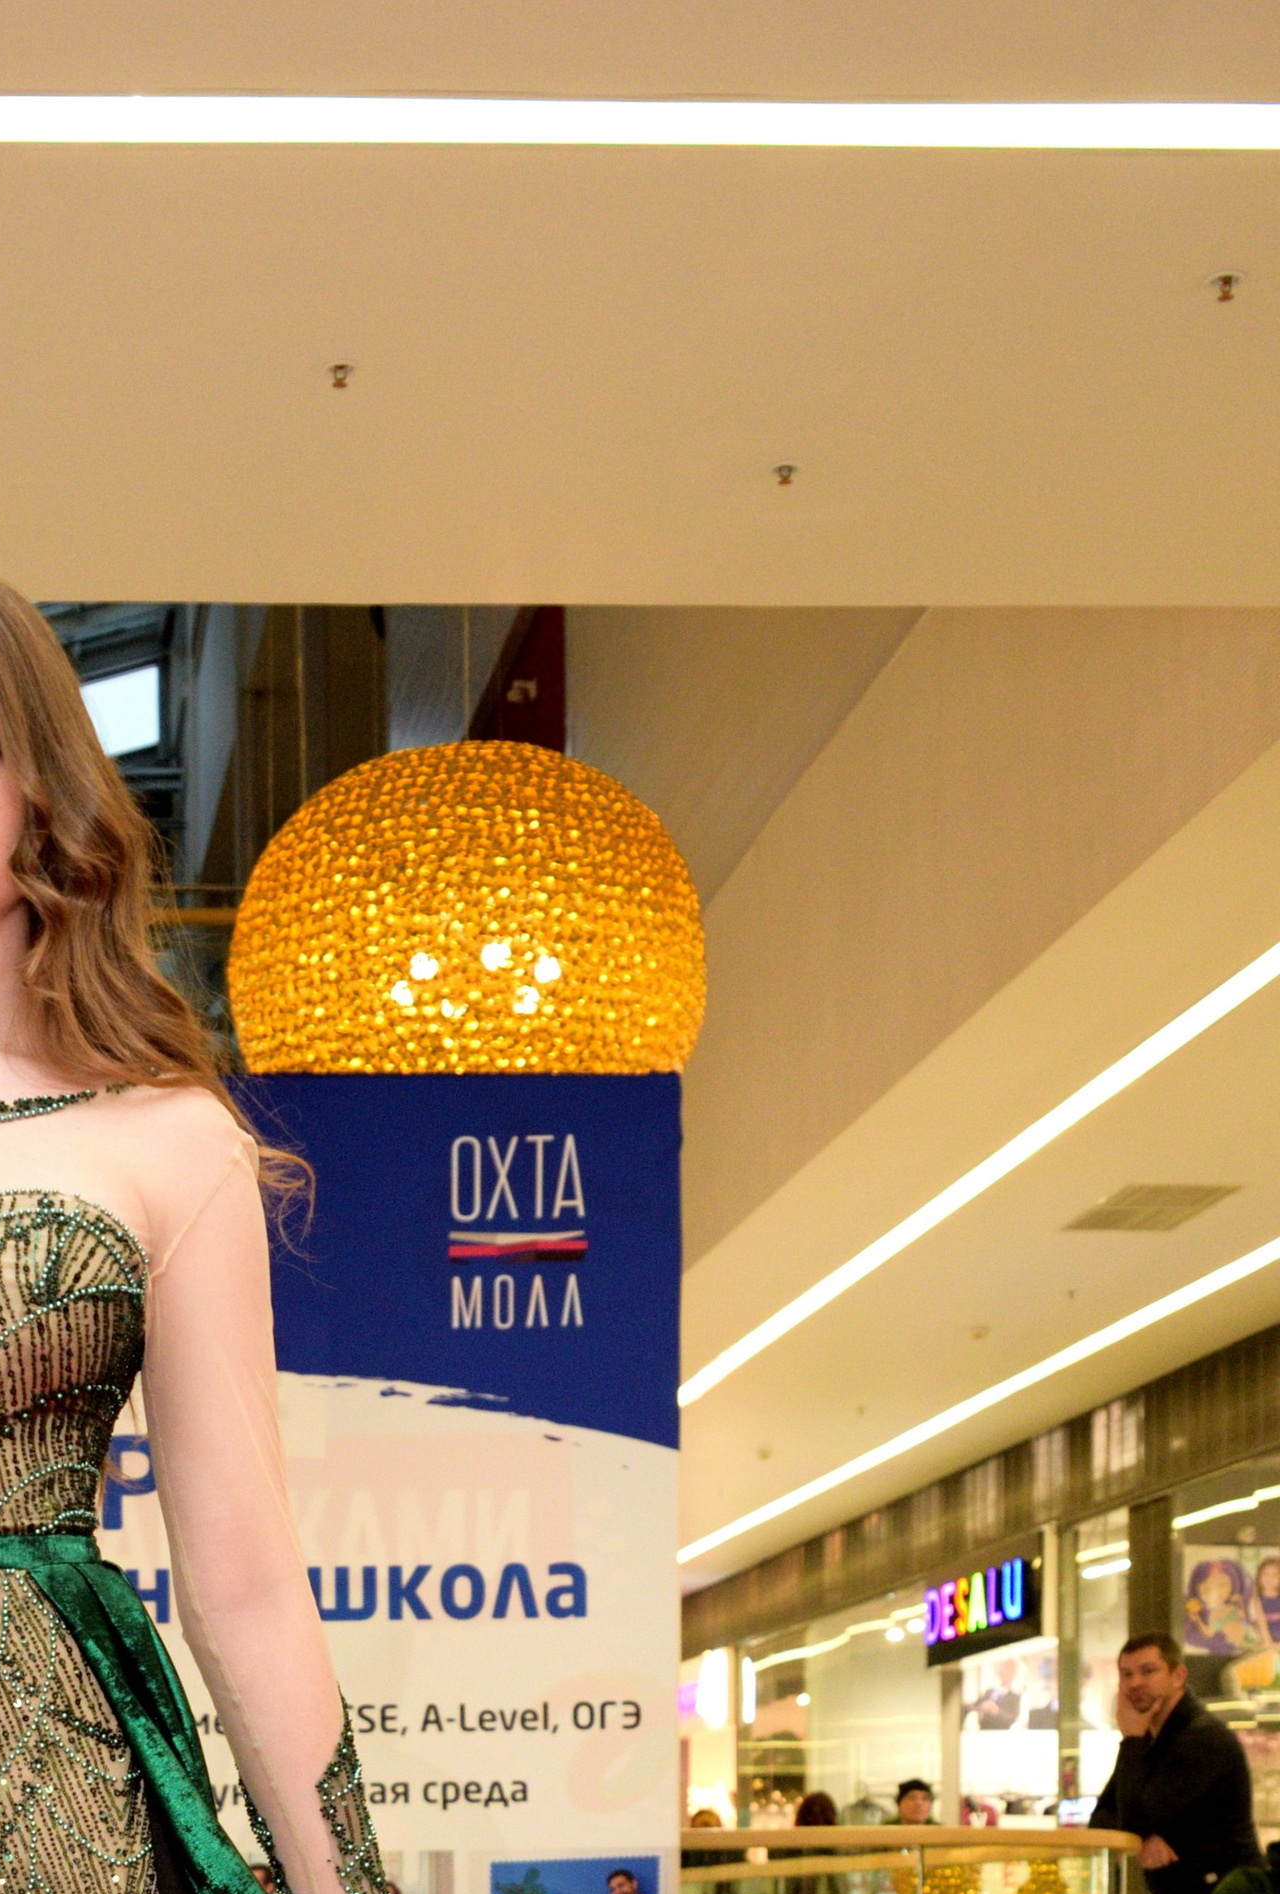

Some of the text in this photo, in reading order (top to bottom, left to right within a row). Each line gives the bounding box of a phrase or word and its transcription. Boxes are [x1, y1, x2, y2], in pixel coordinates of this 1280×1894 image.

[450, 1133, 586, 1222] ОХТА
[451, 1273, 584, 1329] МОЛЛ
[307, 1562, 588, 1621] школа
[923, 1556, 1024, 1647] DESALU
[420, 1702, 559, 1734] A-Level,
[572, 1701, 642, 1730] ОГЭ
[422, 1780, 529, 1810] среда
